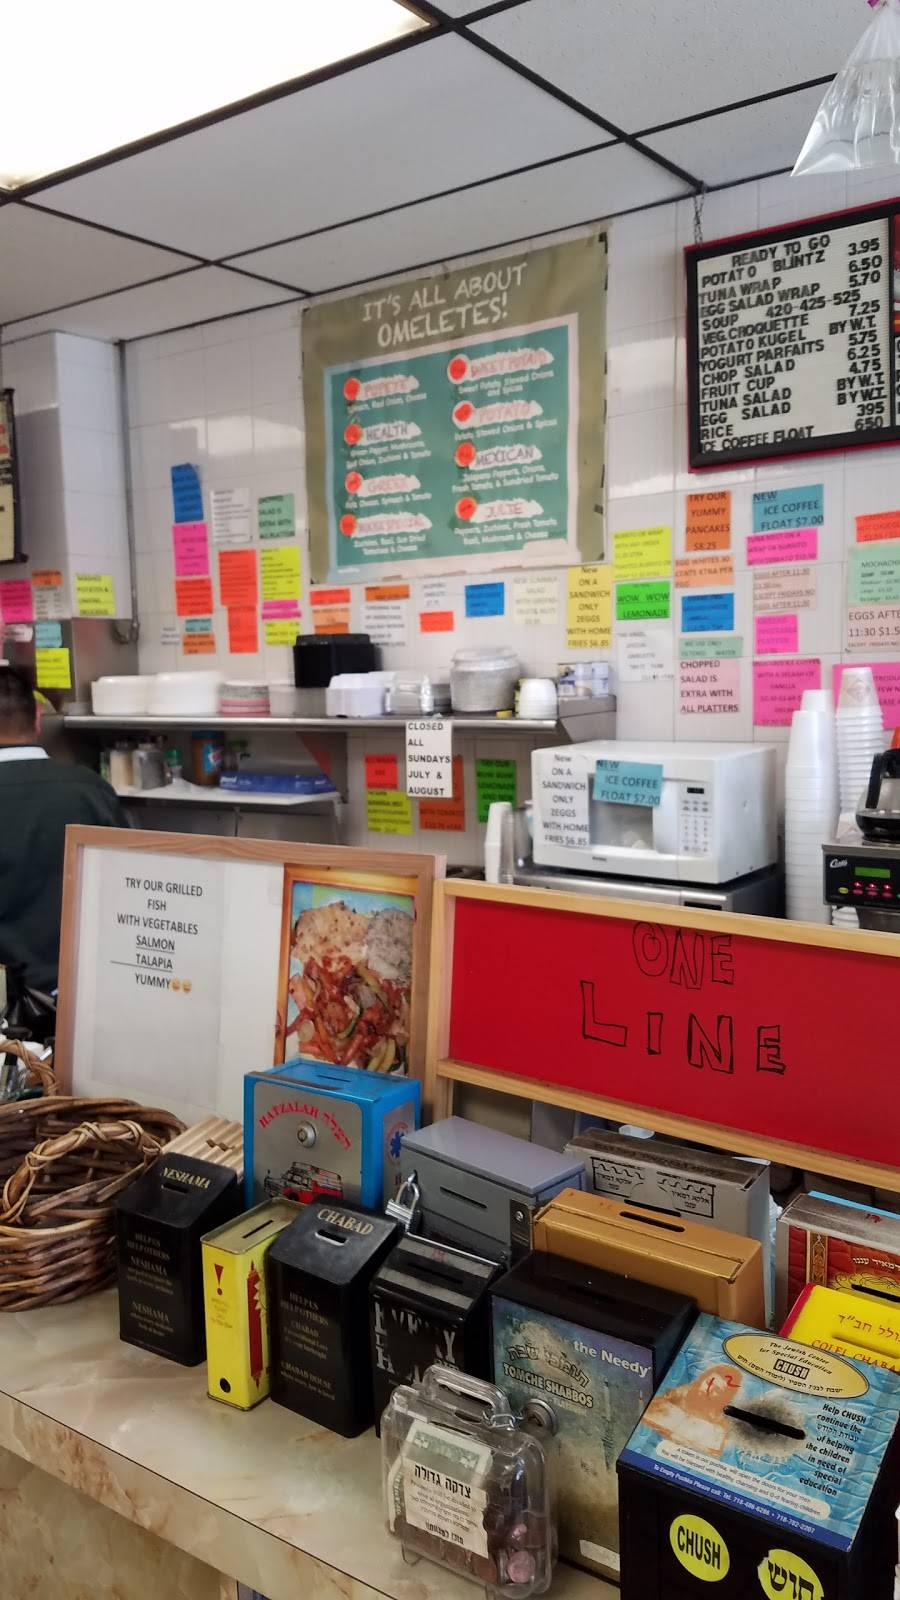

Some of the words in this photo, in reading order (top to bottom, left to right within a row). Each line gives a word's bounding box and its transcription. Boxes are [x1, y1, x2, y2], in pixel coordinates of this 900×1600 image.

[732, 246, 777, 268] READY
[784, 240, 801, 256] TO
[808, 235, 831, 251] GO
[848, 238, 880, 256] 3.95
[773, 250, 826, 273] BLINTZ
[700, 286, 737, 305] TUNA
[740, 277, 781, 297] WRAP
[849, 254, 883, 273] 6.50
[362, 293, 402, 322] IT'S
[409, 285, 448, 311] ALL
[454, 262, 528, 301] ABOUT
[700, 302, 726, 318] EGG
[728, 292, 774, 313] SALAD
[777, 282, 820, 302] WRAP
[849, 270, 881, 288] 5.70
[849, 299, 881, 317] 7.25
[377, 291, 509, 348] OMELETES!
[702, 314, 739, 331] SOUP
[700, 337, 755, 360] POTATO
[758, 325, 807, 348] KUGEL
[829, 319, 848, 335] BY
[700, 352, 753, 373] YOGURT
[757, 339, 825, 363] PARFAITS
[702, 369, 738, 387] CHOP
[744, 359, 796, 379] SALAD
[848, 343, 881, 361] 6.25
[701, 382, 740, 399] FRUIT
[747, 376, 776, 392] CUP
[849, 357, 881, 374] 4.75
[701, 396, 738, 414] TUNA
[743, 387, 792, 406] SALAD
[836, 376, 857, 392] BY
[701, 412, 728, 427] EGG
[742, 401, 791, 420] SALAD
[837, 390, 858, 406] BY
[701, 424, 734, 440] RICE
[722, 432, 769, 450] COFFEE
[753, 490, 778, 502] NEW
[764, 505, 780, 516] ICE
[782, 499, 820, 514] COFFEE
[686, 523, 730, 534] PANCAKES
[761, 518, 793, 531] FLOAT
[796, 514, 825, 528] $7.00
[568, 590, 611, 600] SANDWICH
[616, 593, 640, 603] WOW
[645, 591, 670, 602] WOW
[622, 608, 669, 620] LEMONADE
[848, 611, 875, 621] EGGS
[849, 628, 876, 637] 11:30
[680, 660, 721, 670] CHOPPED
[680, 675, 708, 684] SALAD
[709, 674, 718, 683] IS
[680, 689, 707, 698] EXTRA
[709, 688, 734, 698] WITH
[680, 704, 697, 713] ALL
[698, 702, 741, 713] PLATTERS
[407, 722, 444, 731] CLOSED
[407, 738, 424, 747] ALL
[407, 754, 451, 764] SUNDAYS
[553, 754, 572, 763] New
[597, 760, 620, 770] NEW
[407, 771, 431, 781] JULY
[436, 771, 443, 780] &
[551, 767, 564, 777] ON
[408, 786, 445, 796] AUGUST
[542, 780, 587, 792] SANDWICH
[604, 775, 620, 786] ICE
[622, 776, 658, 789] COFFEE
[551, 795, 574, 804] ONLY
[600, 790, 631, 802] FLOAT
[543, 820, 563, 831] WITH
[564, 822, 592, 833] HOME
[544, 834, 564, 845] FRIES
[125, 877, 142, 889] TRY
[143, 879, 164, 892] OUR
[165, 882, 204, 897] GRILLED
[147, 898, 167, 911] FISH
[117, 912, 141, 926] WITH
[143, 916, 199, 936] VEGETABLES
[136, 935, 176, 951] SALMON
[135, 953, 174, 970] TALAPIA
[631, 921, 735, 991] ONE
[134, 972, 172, 990] YUMMY
[579, 979, 788, 1076] LINE
[161, 1167, 211, 1189] NESHAMA
[316, 1208, 374, 1237] CHABAD
[573, 1340, 598, 1358] the
[769, 1341, 783, 1350] The
[782, 1344, 807, 1357] Jewish
[807, 1350, 830, 1366] Center
[772, 1349, 797, 1361] Special
[798, 1357, 833, 1376] Education
[775, 1360, 809, 1378] CHUSH
[502, 1362, 545, 1391] TOMCHE
[545, 1379, 595, 1409] SHABBOS
[822, 1403, 840, 1416] Help
[841, 1410, 867, 1424] CHUSH
[816, 1413, 848, 1430] continue
[849, 1424, 862, 1435] the
[805, 1442, 818, 1452] the
[819, 1446, 850, 1464] children
[816, 1436, 826, 1444] of
[826, 1438, 855, 1455] helping
[807, 1454, 816, 1464] in
[817, 1458, 837, 1472] need
[838, 1466, 847, 1475] of
[414, 1464, 442, 1488] גדולה
[814, 1469, 842, 1486] special
[445, 1476, 472, 1499] צדקה
[799, 1477, 837, 1497] education
[677, 1525, 721, 1570] CHUSH
